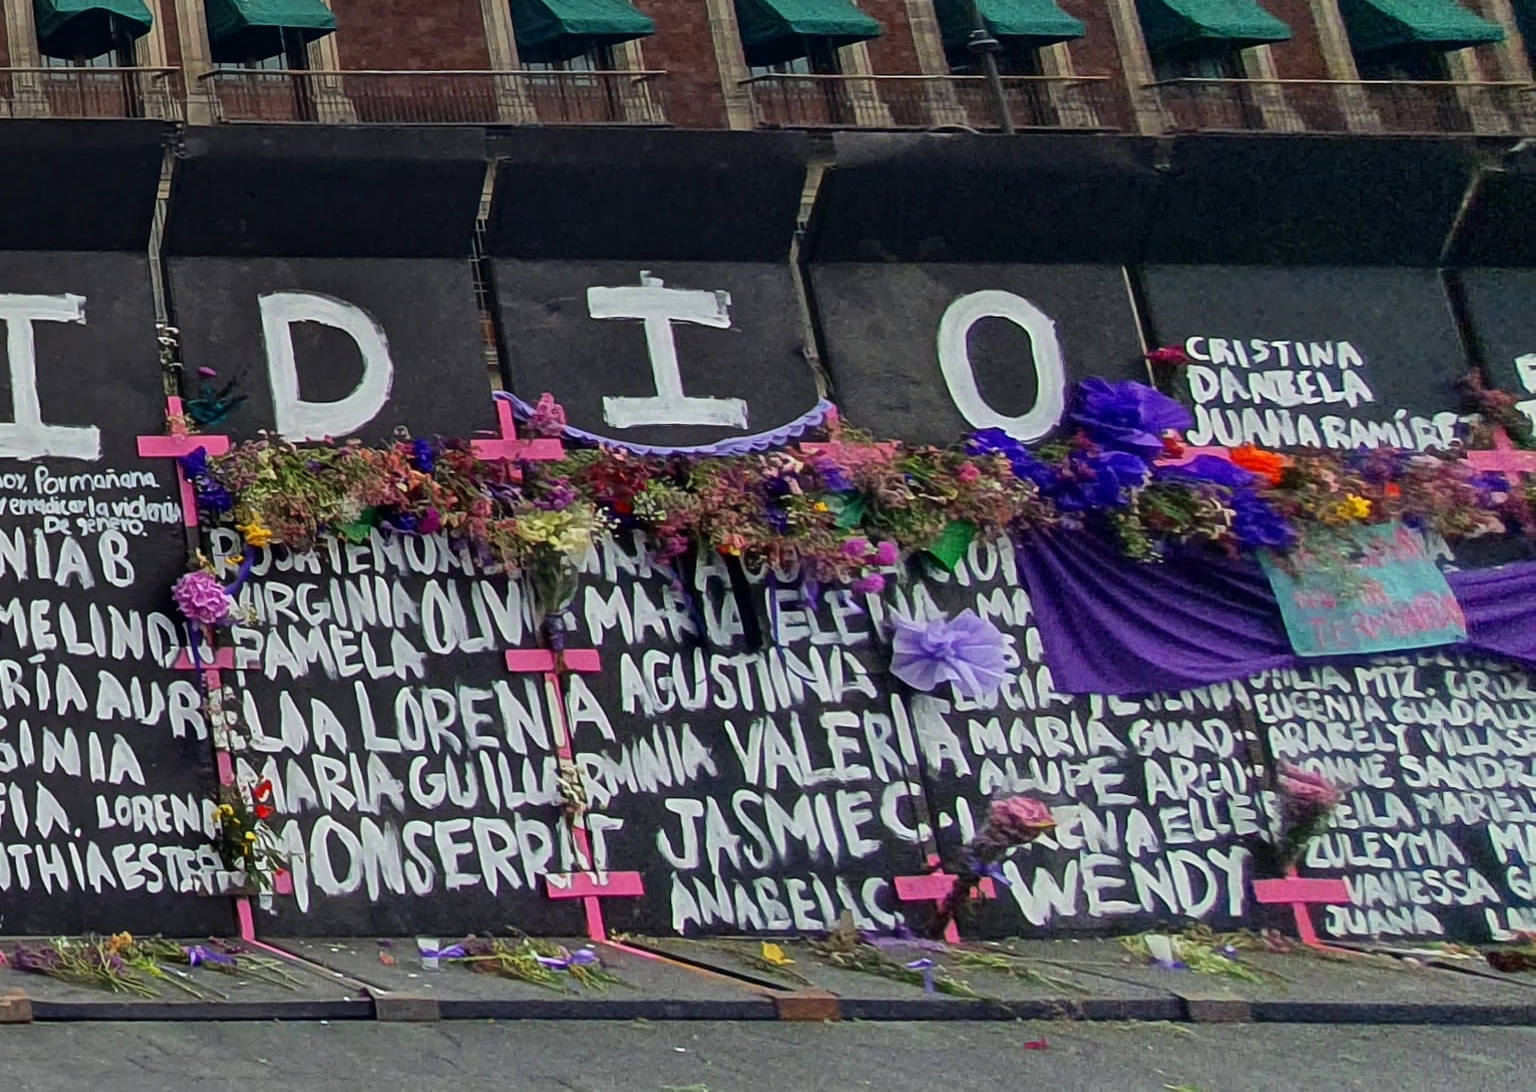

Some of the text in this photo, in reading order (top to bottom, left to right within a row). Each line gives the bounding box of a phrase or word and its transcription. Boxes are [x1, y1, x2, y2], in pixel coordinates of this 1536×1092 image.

[1185, 336, 1364, 368] CRISTINA
[1319, 409, 1484, 452] RAMÍRE
[98, 529, 135, 588] B
[231, 625, 427, 688] PAMELA
[619, 645, 879, 717] AGUSTINA
[354, 680, 615, 755] LORENA
[967, 710, 1127, 759] MARIA
[95, 792, 225, 841] LORENA
[1001, 845, 1252, 927] WENDY
